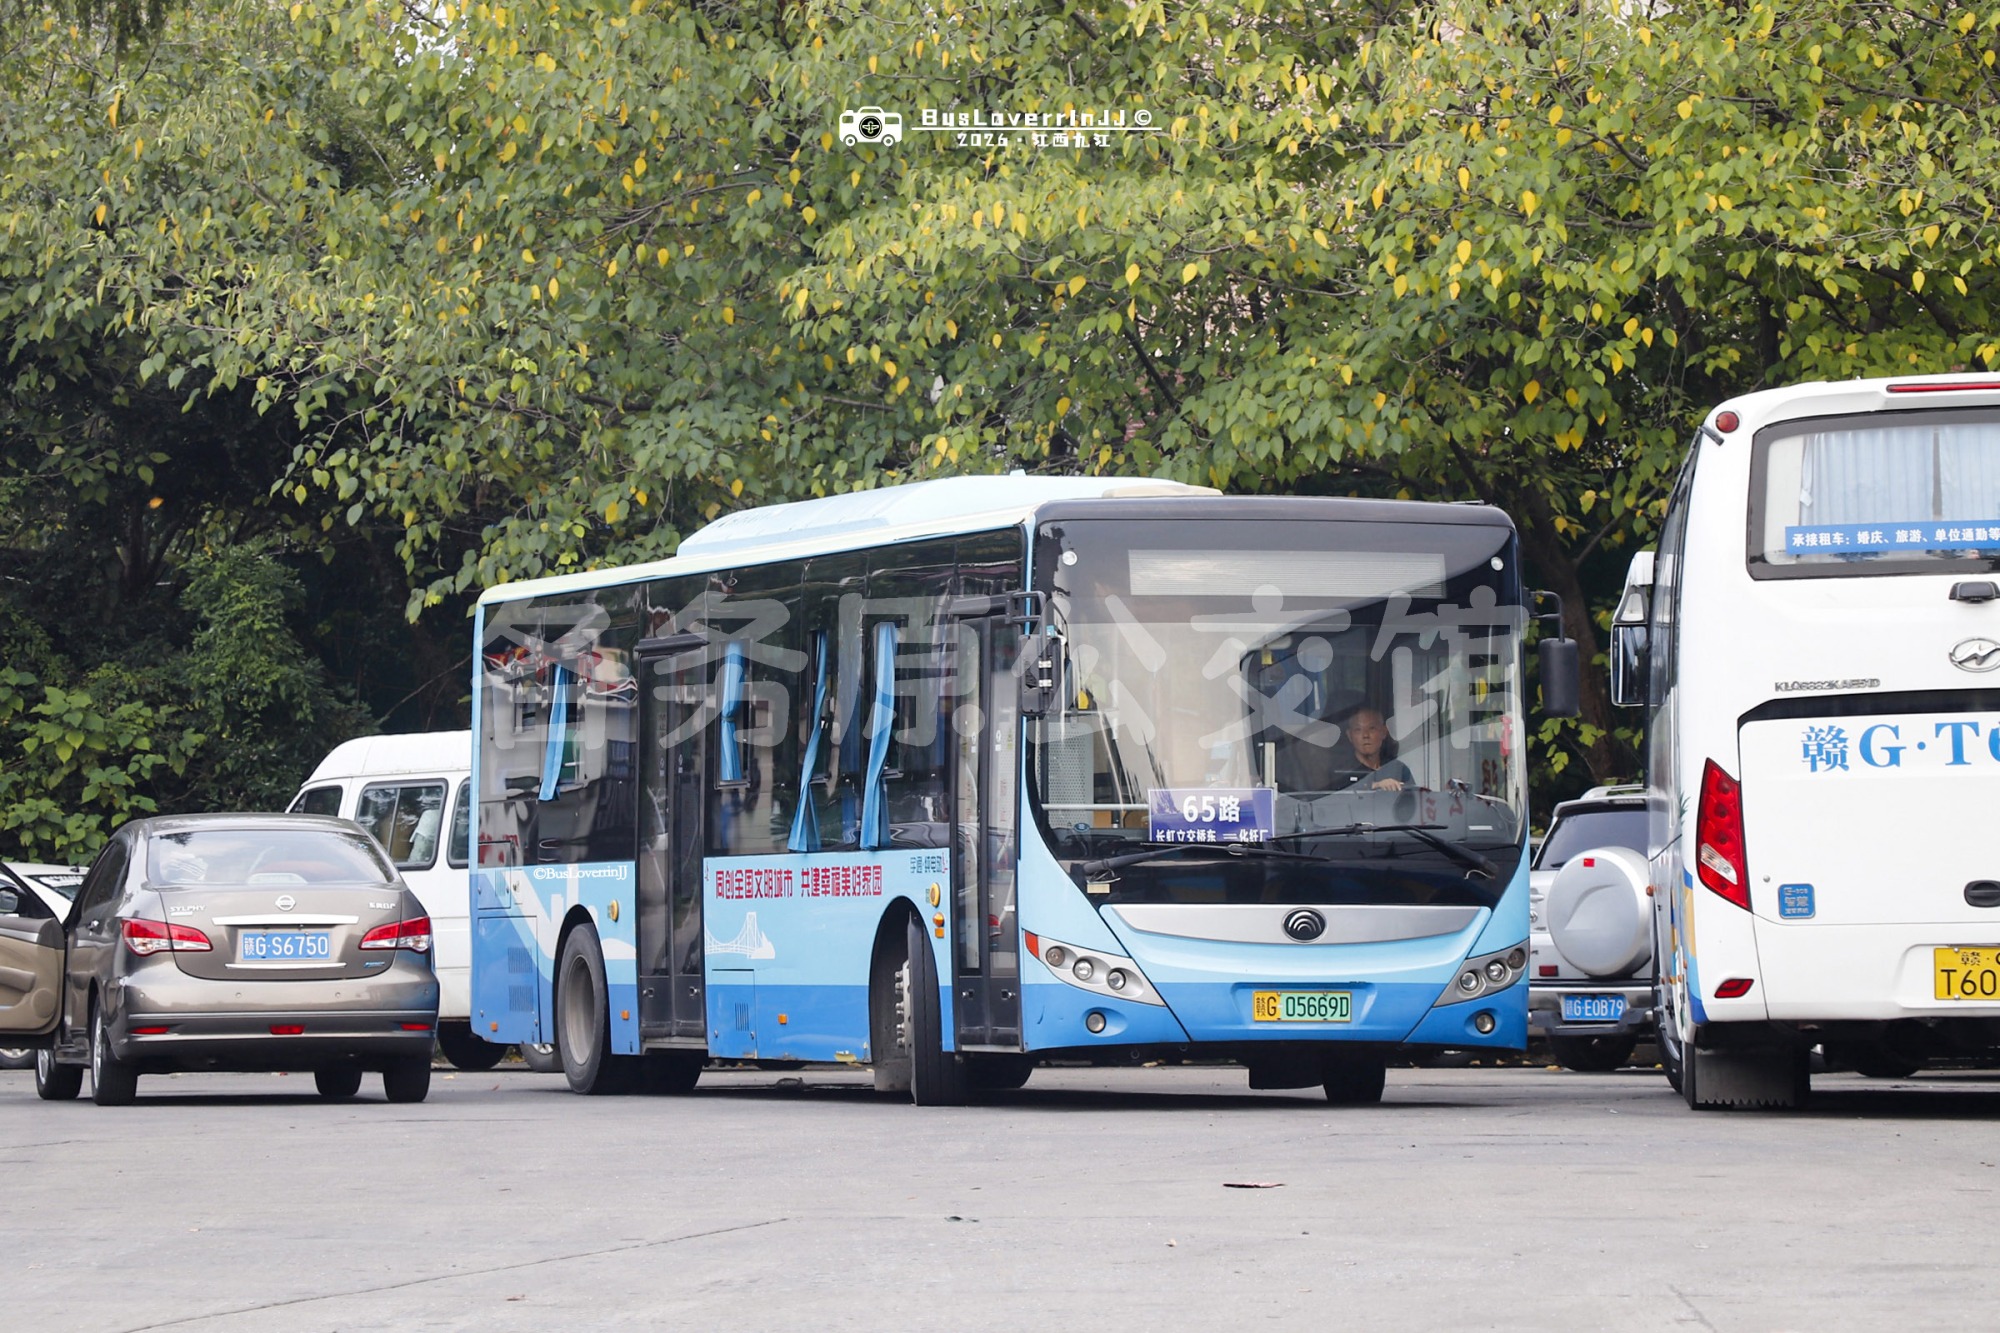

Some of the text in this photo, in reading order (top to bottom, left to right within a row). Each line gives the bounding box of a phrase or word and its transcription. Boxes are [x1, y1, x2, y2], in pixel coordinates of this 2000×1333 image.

[1182, 795, 1240, 823] 65路
[716, 869, 793, 899] 同创全国文明城市
[801, 865, 882, 897] 共建幸福美好家园
[1940, 968, 1997, 996] T60
